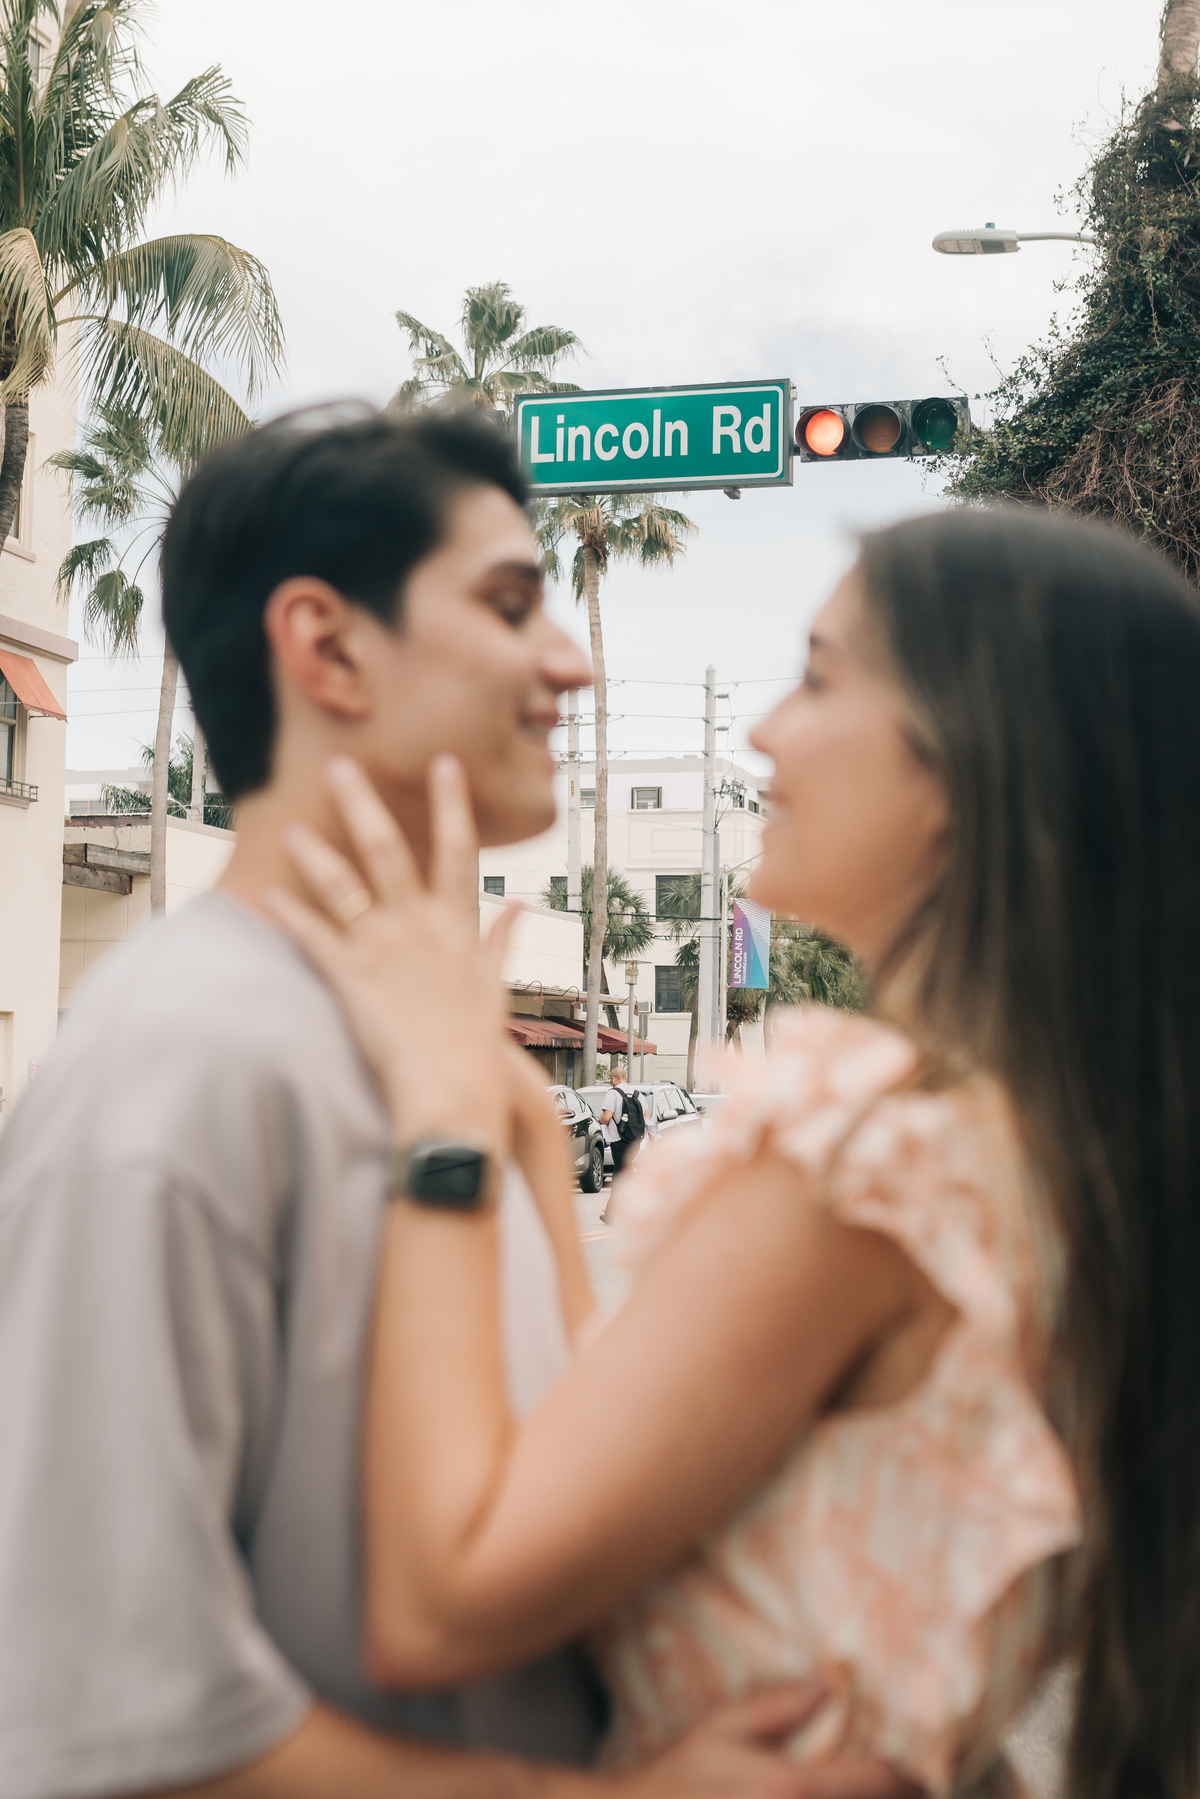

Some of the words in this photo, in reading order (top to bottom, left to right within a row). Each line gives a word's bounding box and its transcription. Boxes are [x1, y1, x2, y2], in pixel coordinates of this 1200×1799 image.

[531, 409, 688, 463] Lincoln
[712, 403, 771, 454] Rd
[735, 927, 743, 941] RD
[733, 942, 743, 984] LINCOLN
